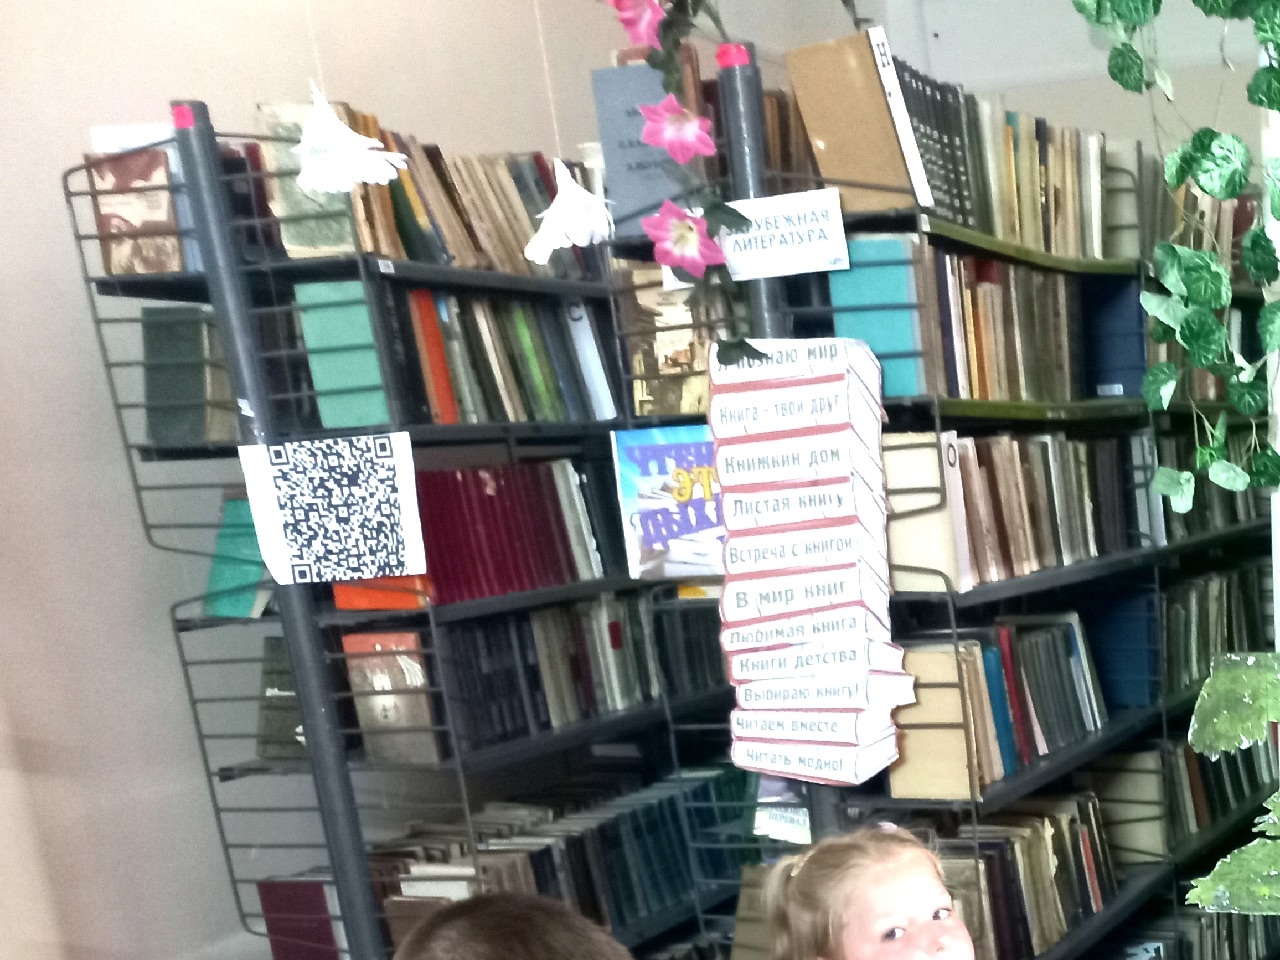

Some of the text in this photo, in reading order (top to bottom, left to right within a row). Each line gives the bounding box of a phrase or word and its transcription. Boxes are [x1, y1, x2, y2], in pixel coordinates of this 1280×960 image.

[733, 227, 828, 252] ЛИТЕРАТУРА
[807, 343, 838, 362] мир
[719, 406, 759, 425] Книга
[810, 394, 839, 415] друг
[724, 448, 841, 474] Книжкин дом
[733, 493, 843, 517] Листая книгу
[729, 542, 786, 564] Встреча
[791, 543, 800, 557] с
[735, 580, 846, 608] В мир книг
[730, 616, 857, 644] Любимая книга
[740, 648, 857, 673] Книги детства
[744, 686, 810, 703] Выбираю
[736, 716, 838, 733] Читаем вместе
[746, 748, 843, 772] Читать модно!
